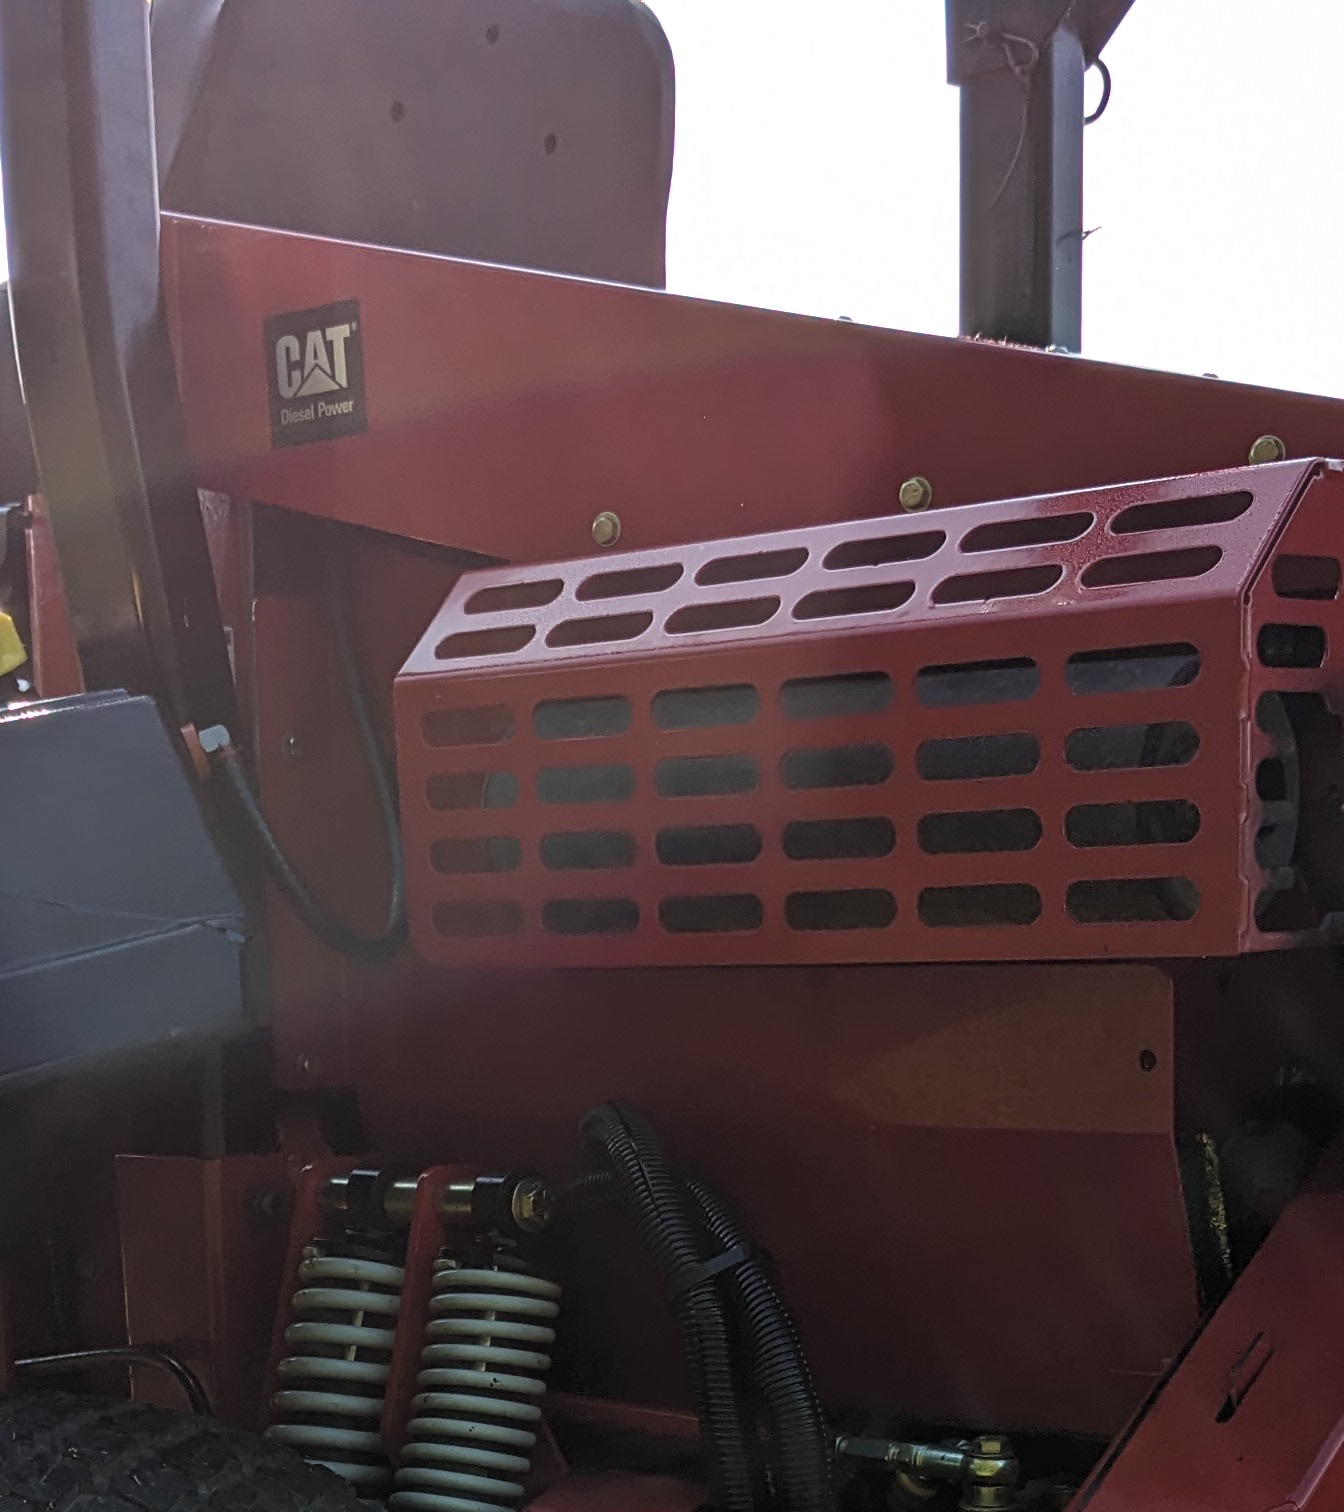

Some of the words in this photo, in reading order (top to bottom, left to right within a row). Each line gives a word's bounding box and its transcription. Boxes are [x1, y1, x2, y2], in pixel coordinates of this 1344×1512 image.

[275, 323, 352, 399] CAT
[281, 404, 315, 425] Diesel
[318, 399, 355, 418] Power
